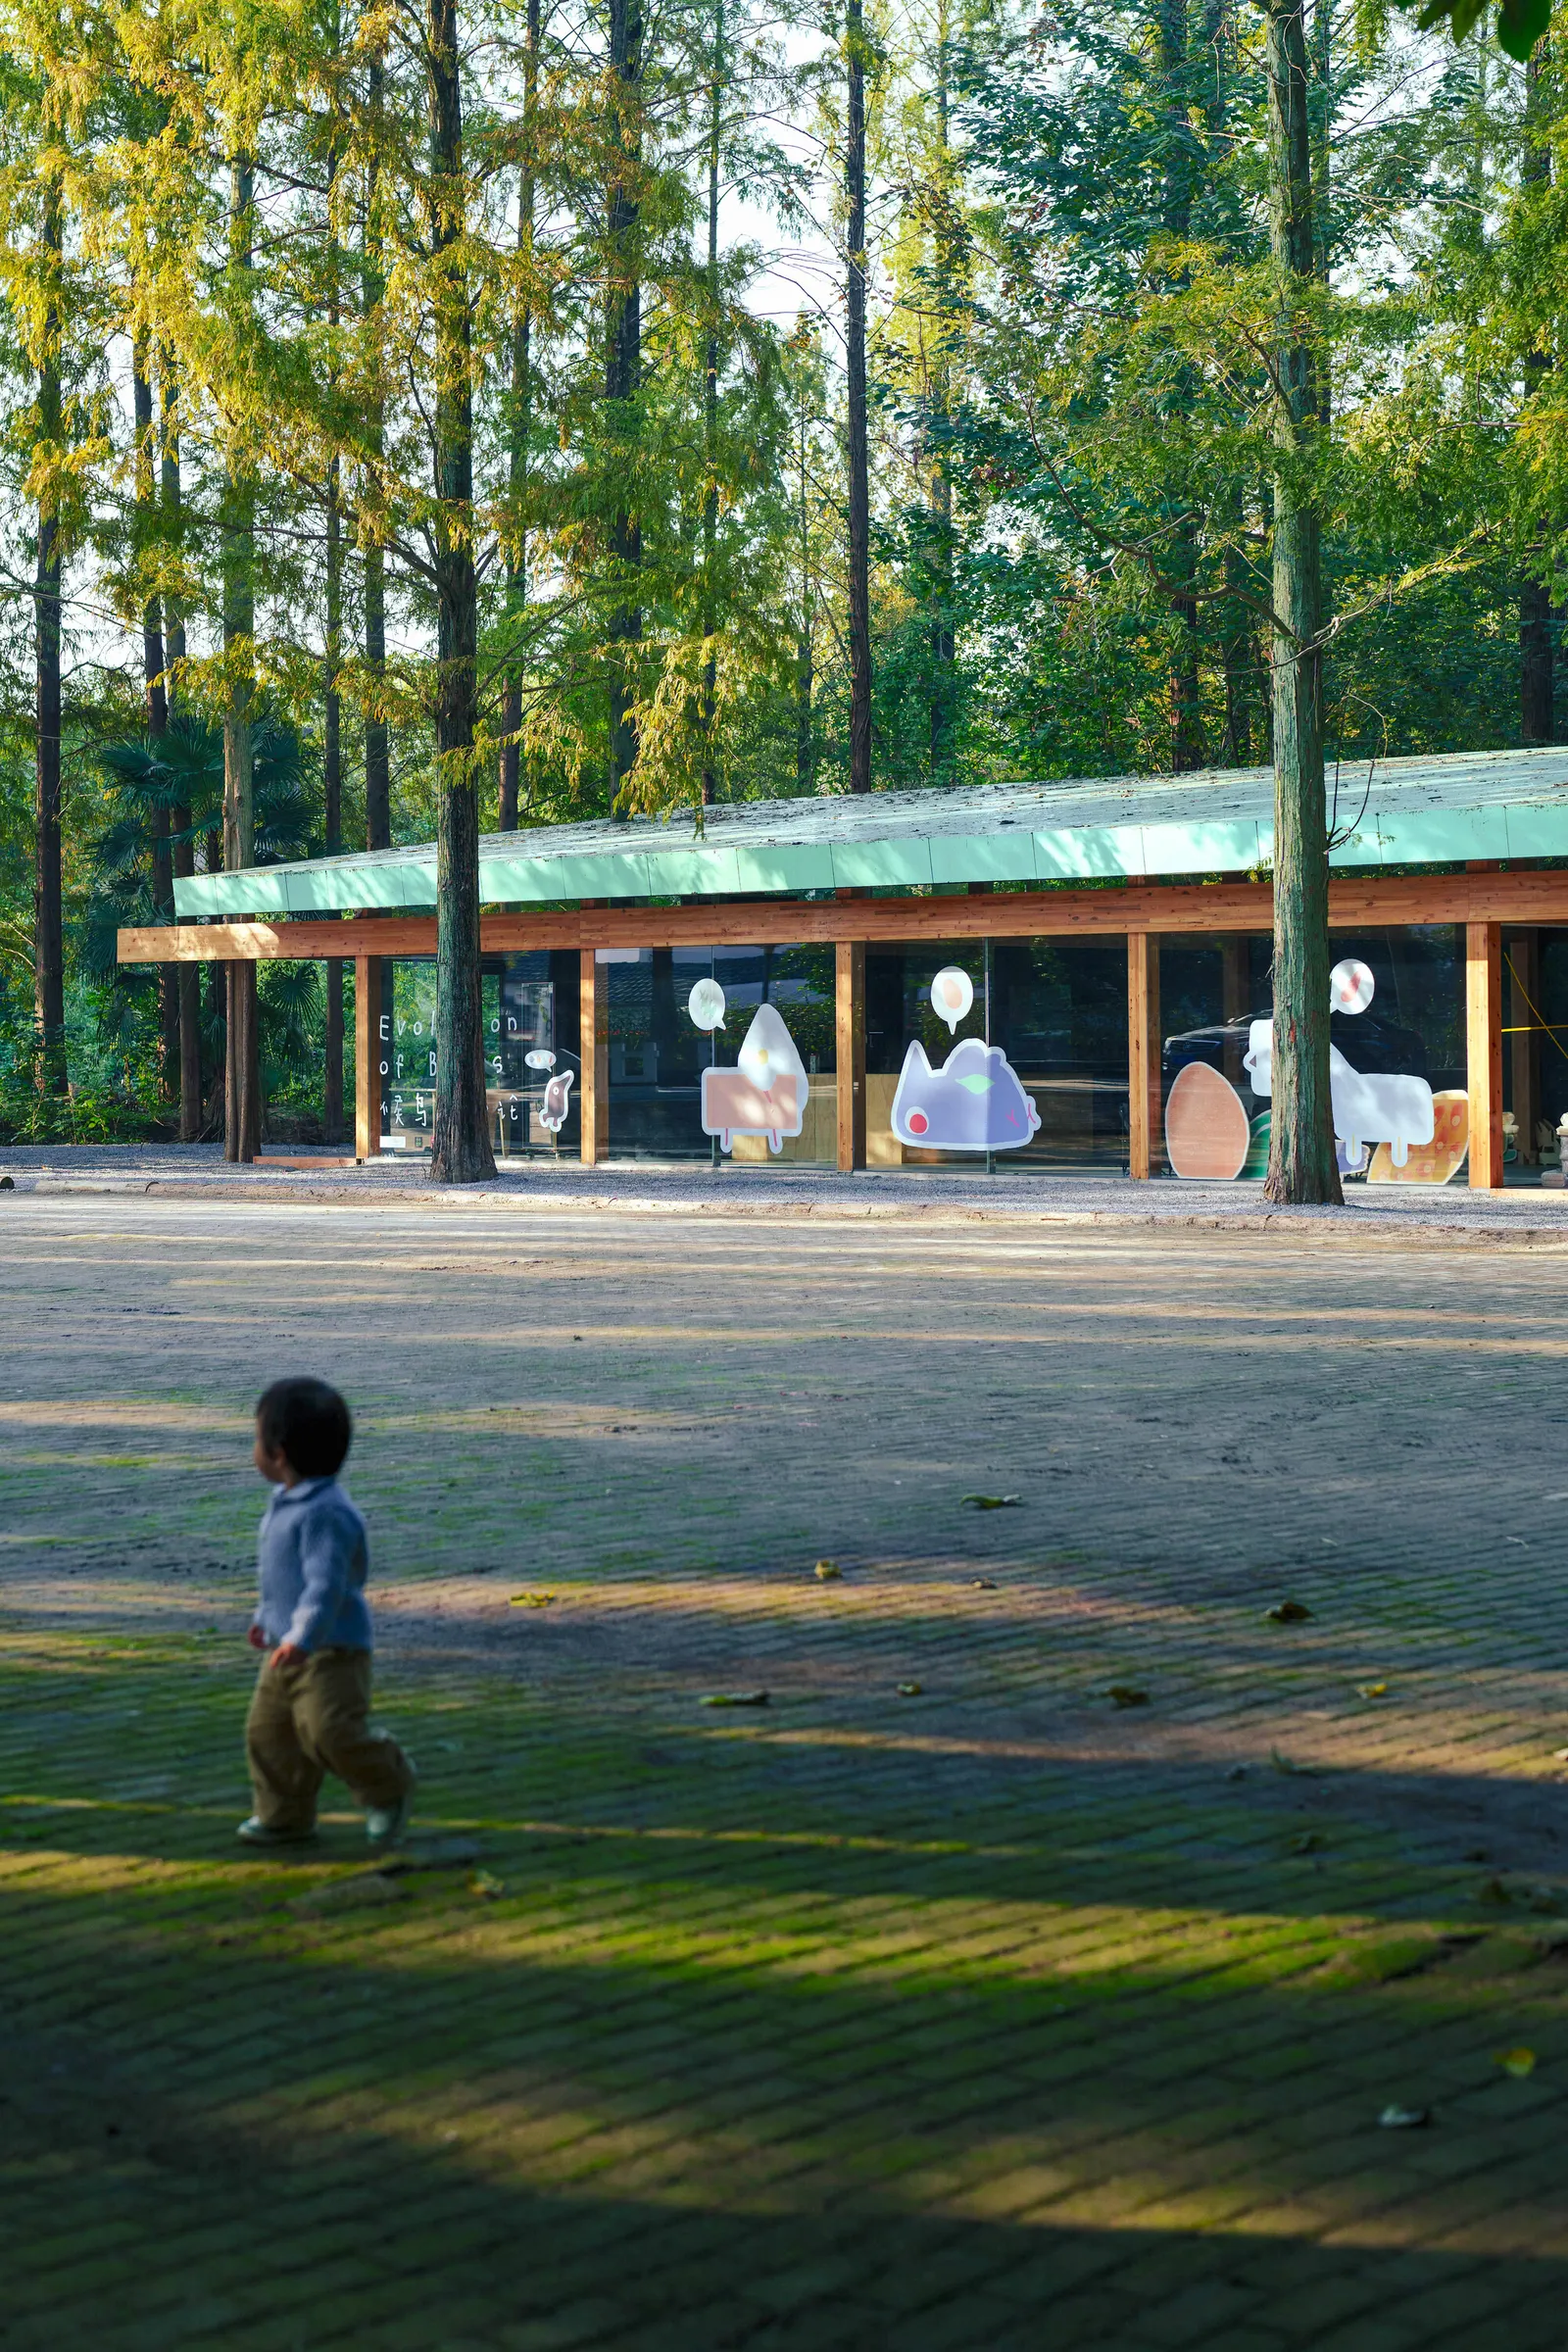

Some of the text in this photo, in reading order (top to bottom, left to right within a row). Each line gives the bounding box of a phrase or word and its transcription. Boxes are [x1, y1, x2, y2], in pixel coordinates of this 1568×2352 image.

[379, 1010, 517, 1041] Evolon
[379, 1054, 404, 1079] of
[379, 1092, 518, 1127] 候鸟论
